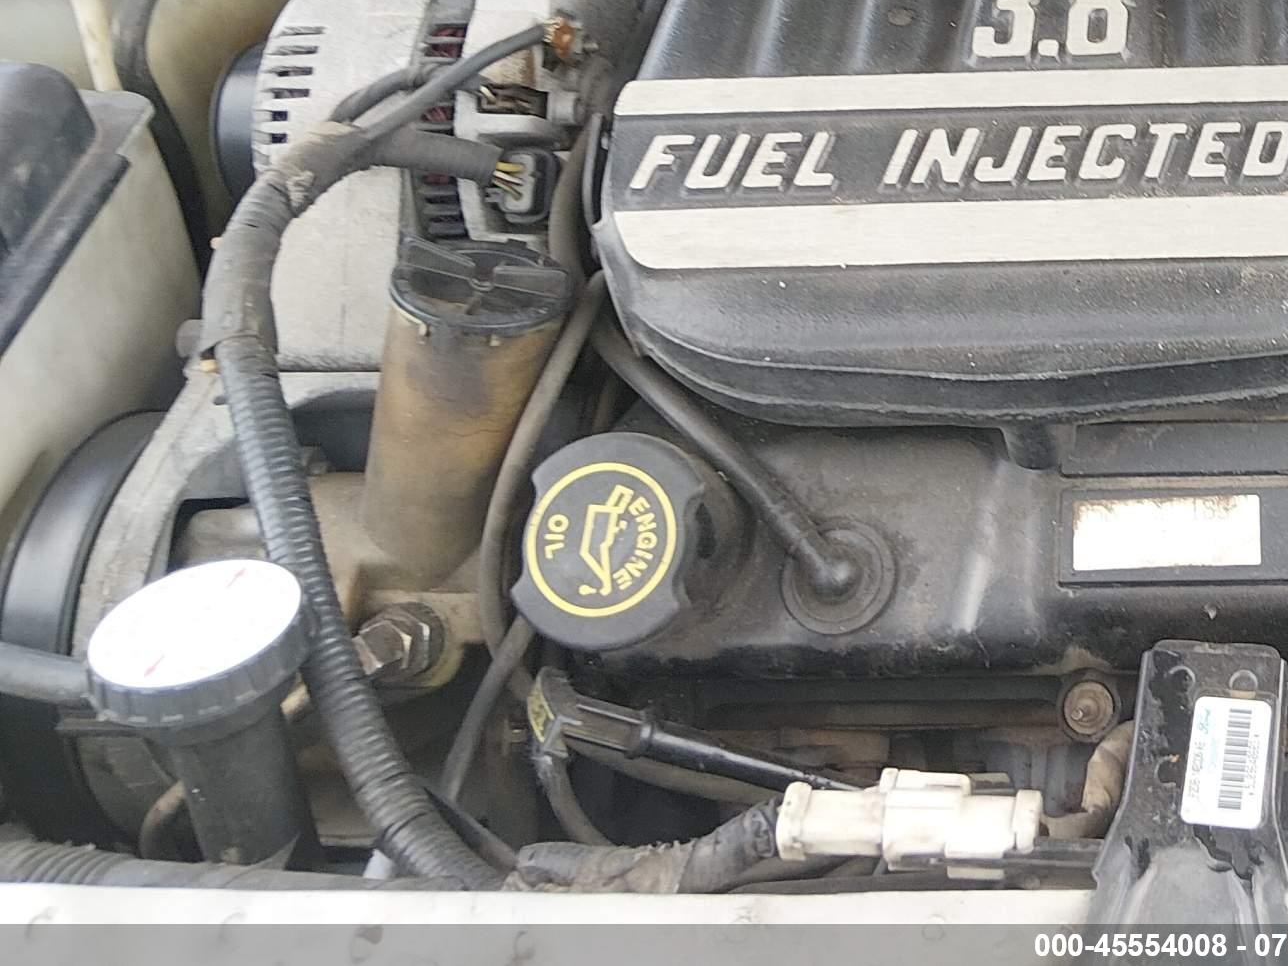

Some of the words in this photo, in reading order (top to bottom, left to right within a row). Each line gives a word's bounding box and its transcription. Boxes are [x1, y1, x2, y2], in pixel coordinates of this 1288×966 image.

[629, 131, 836, 191] FUEL
[543, 513, 570, 560] OIL
[612, 495, 659, 591] ENGINE
